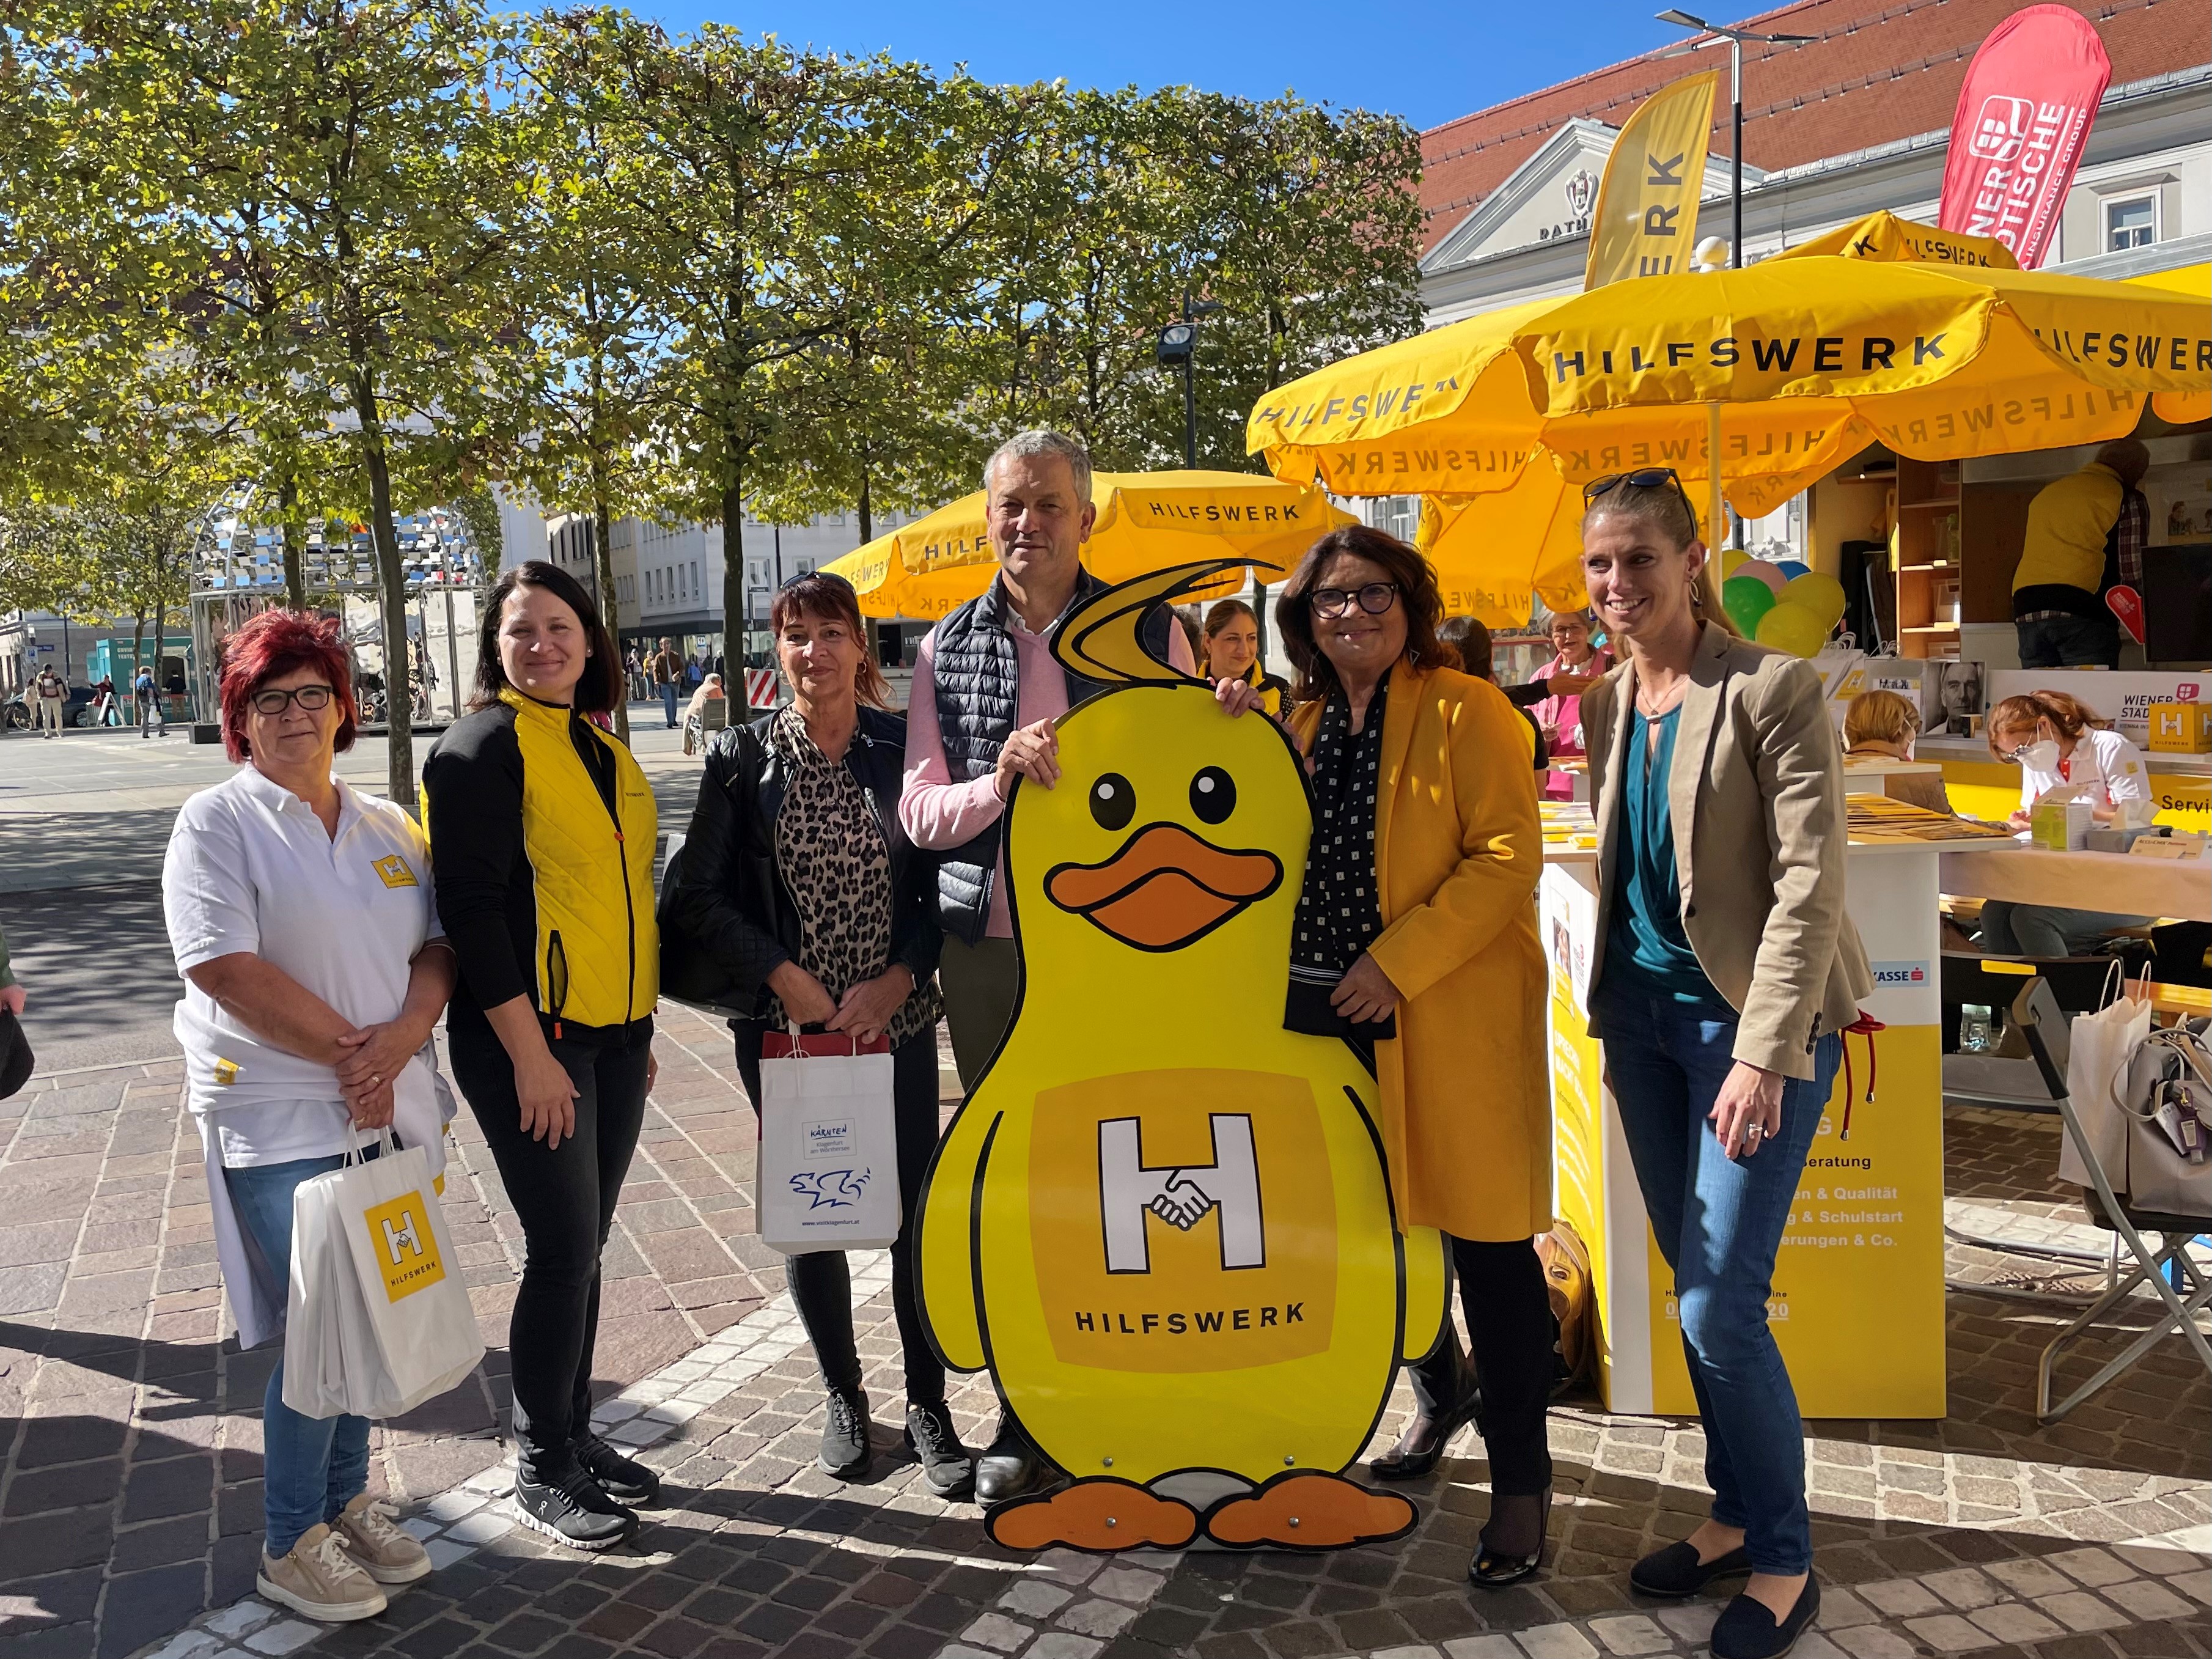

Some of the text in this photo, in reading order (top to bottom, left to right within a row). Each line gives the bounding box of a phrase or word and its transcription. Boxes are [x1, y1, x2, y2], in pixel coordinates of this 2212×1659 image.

[1555, 333, 1948, 383] HILFSWERK
[2035, 329, 2212, 371] ILFSWER
[1255, 376, 1458, 427] HILFSWE
[1149, 502, 1300, 522] HILFSWERK
[925, 535, 987, 561] HILF
[2162, 795, 2210, 814] Servi
[1817, 1188, 1828, 1199] &
[1834, 1186, 1898, 1200] Qualität
[1802, 1211, 1813, 1223] &
[1820, 1211, 1903, 1223] Schulstart
[1854, 1234, 1865, 1246] &
[1870, 1234, 1898, 1246] Co.
[391, 1261, 436, 1287] HILFSWERK
[1075, 1302, 1304, 1334] HILFSWERK
